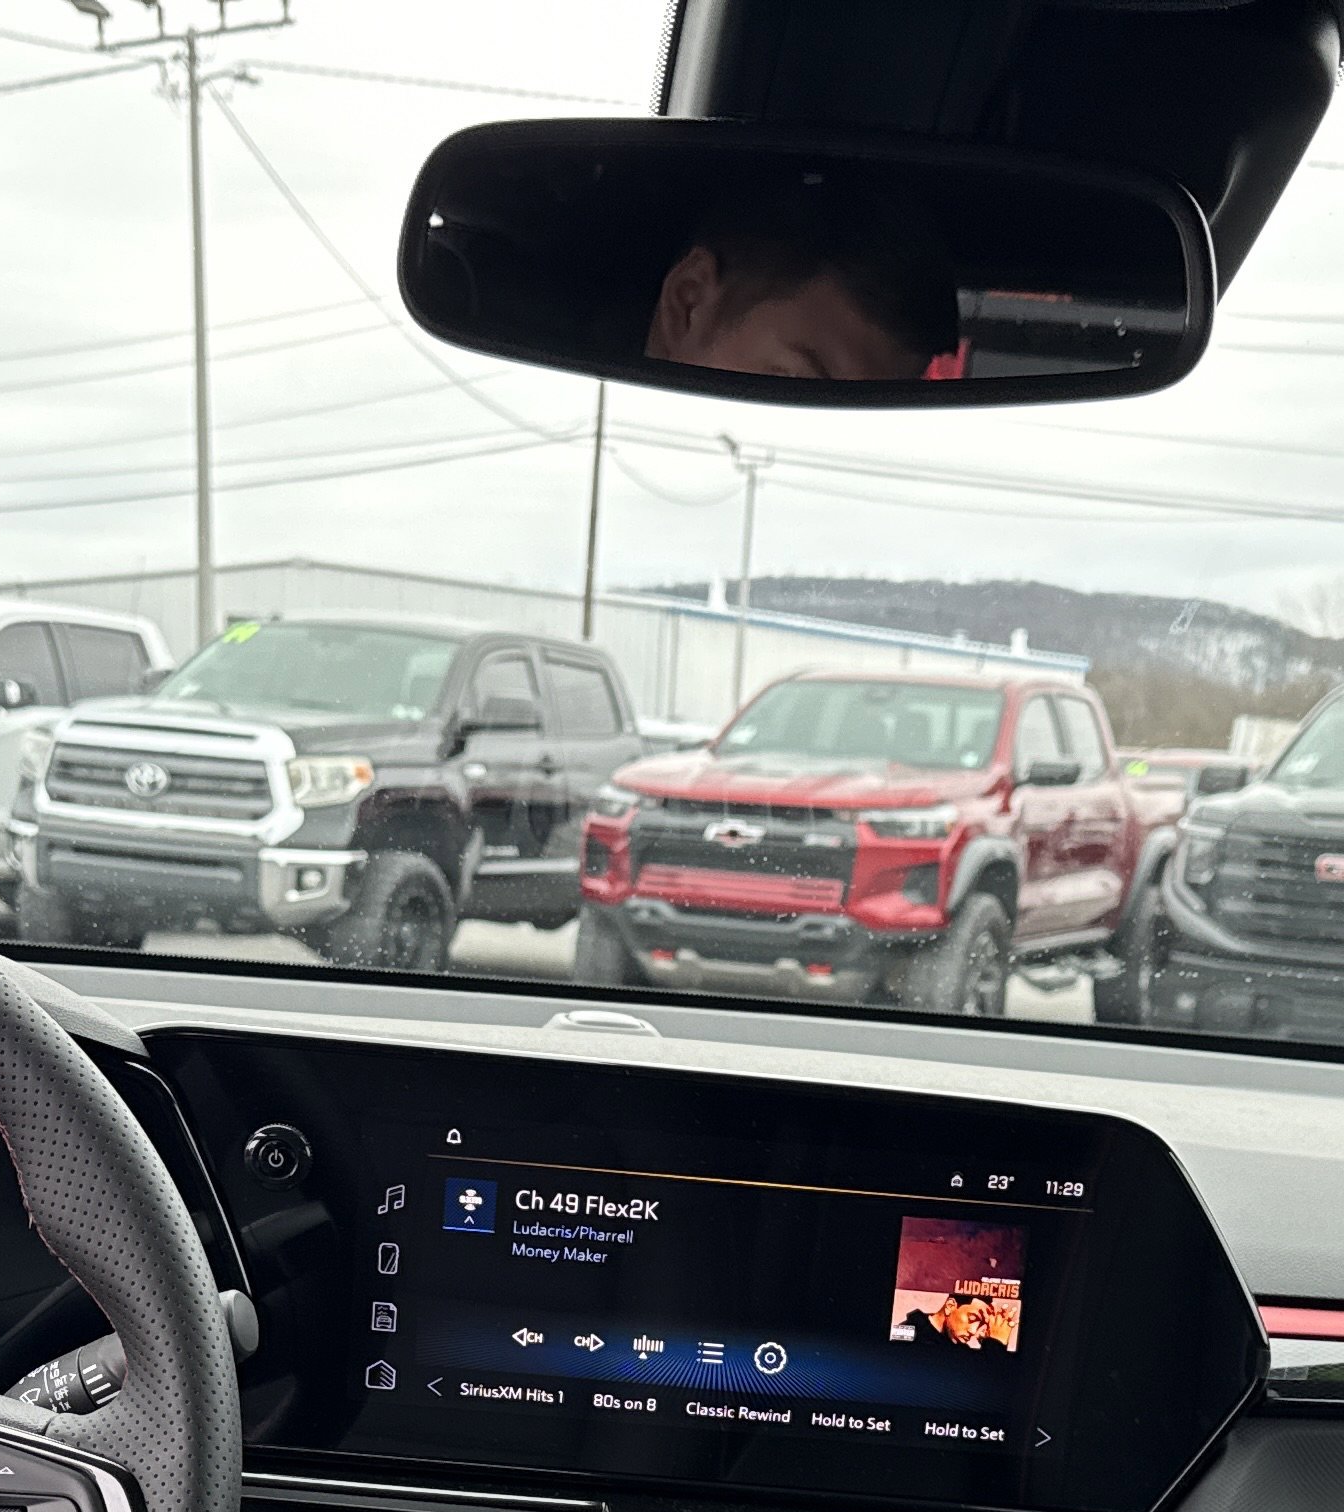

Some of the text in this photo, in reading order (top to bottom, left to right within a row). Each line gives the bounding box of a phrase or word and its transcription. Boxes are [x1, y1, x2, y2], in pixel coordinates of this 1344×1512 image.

[1045, 1180, 1084, 1197] 11:29
[515, 1189, 659, 1221] Ch 49 Flex2K
[512, 1220, 634, 1244] Ludacris/Pharrell
[511, 1242, 608, 1264] Money Maker
[954, 1280, 1021, 1299] LUDACRIS
[460, 1382, 564, 1404] SiriusXM Hits 1
[593, 1393, 657, 1412] 80s on 8
[685, 1401, 791, 1423] Classic Rewind
[811, 1412, 891, 1432] Hold to Set
[924, 1421, 1005, 1441] Hold to Set
